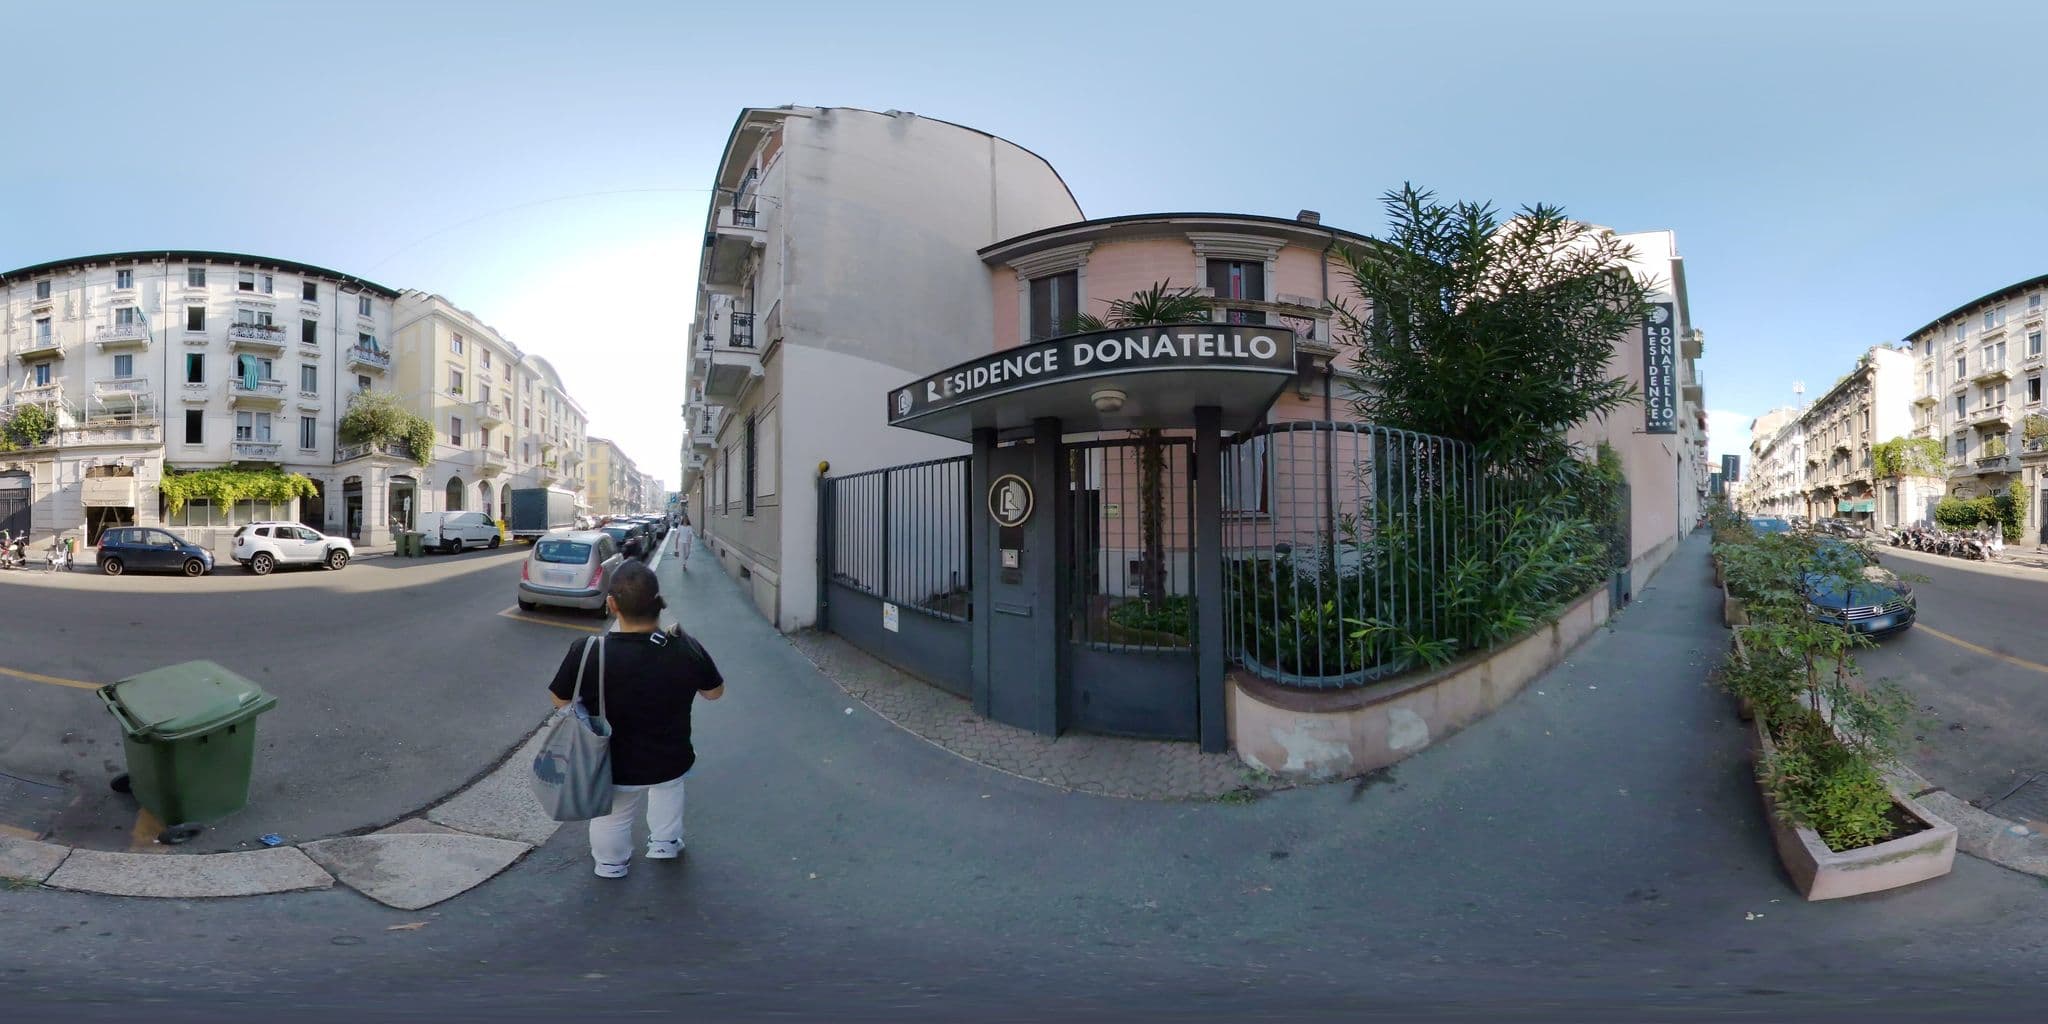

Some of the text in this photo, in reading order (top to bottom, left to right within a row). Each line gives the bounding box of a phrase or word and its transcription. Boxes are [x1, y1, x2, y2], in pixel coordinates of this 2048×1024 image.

[927, 333, 1278, 402] RESIDENCE DONATELLO
[1648, 326, 1660, 420] RESIDENCE
[1660, 326, 1674, 419] DONATELLO
